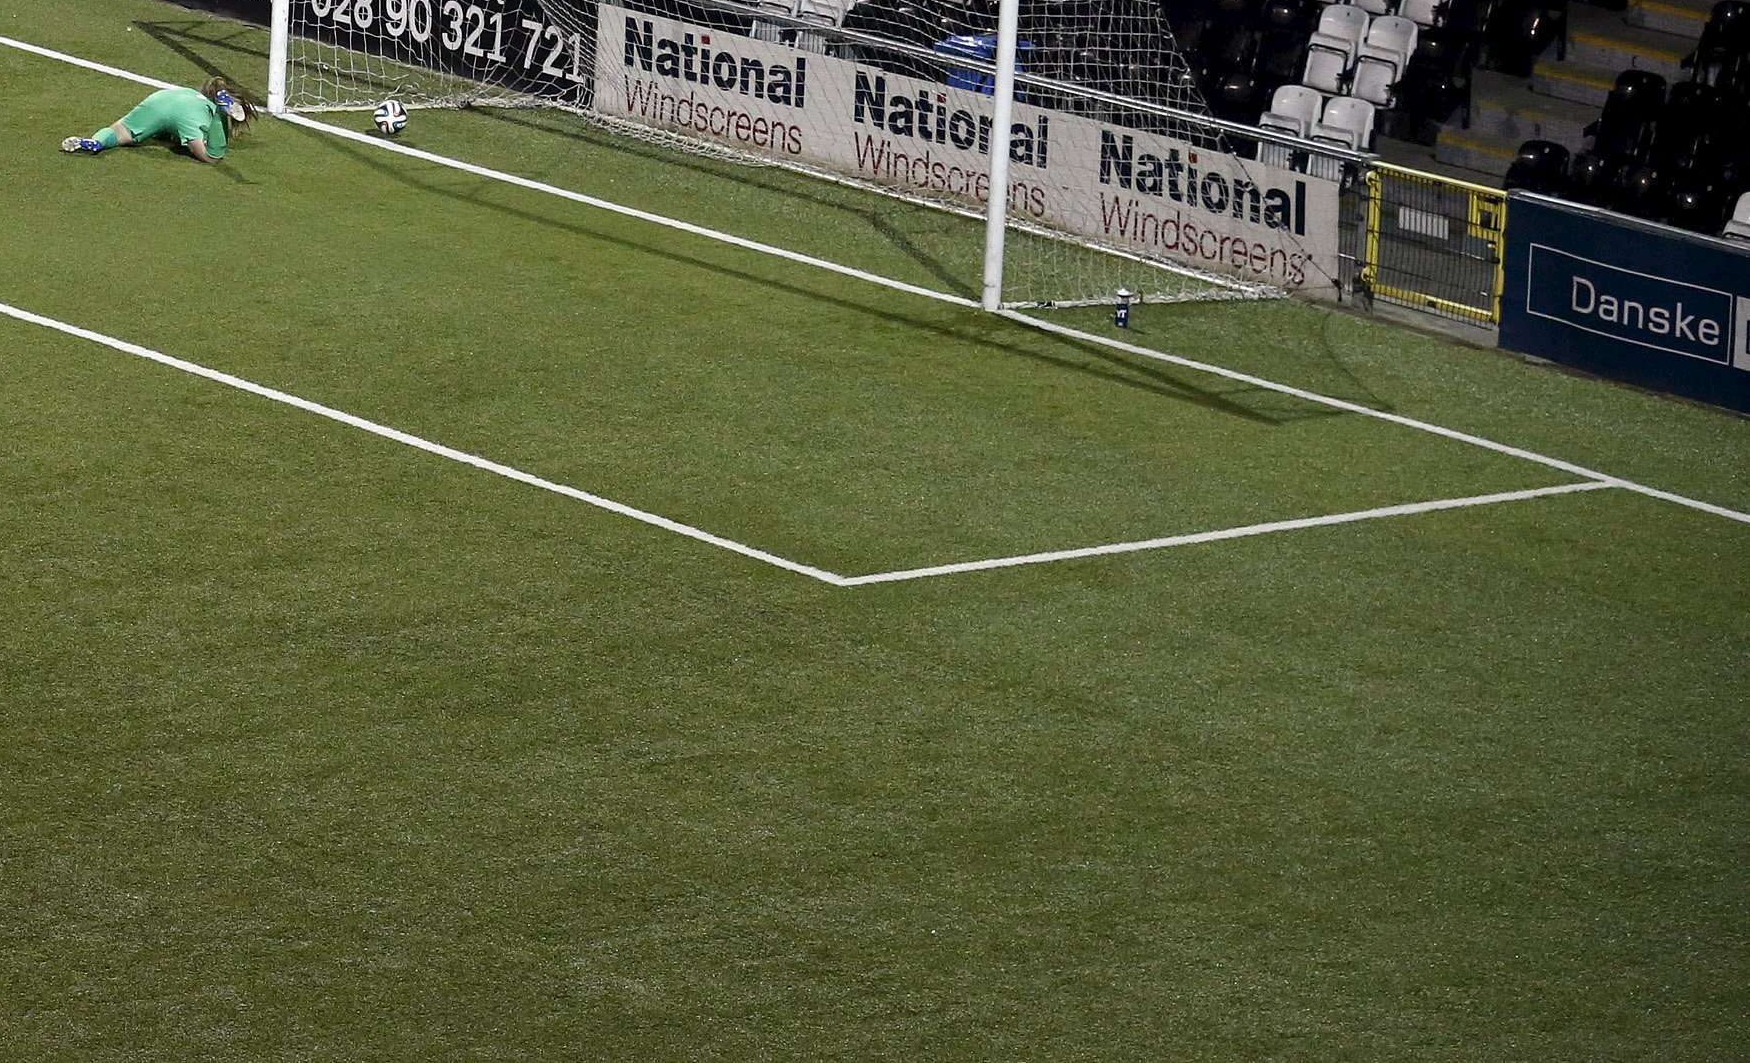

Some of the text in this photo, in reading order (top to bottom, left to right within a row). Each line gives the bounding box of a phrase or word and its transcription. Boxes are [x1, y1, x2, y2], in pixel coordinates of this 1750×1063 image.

[441, 0, 507, 64] 321
[520, 18, 586, 84] 721
[623, 16, 807, 108] National
[624, 73, 804, 156] Windscreens
[1099, 129, 1307, 237] National
[1100, 192, 1306, 287] Windscreens
[1571, 275, 1721, 347] Danske
